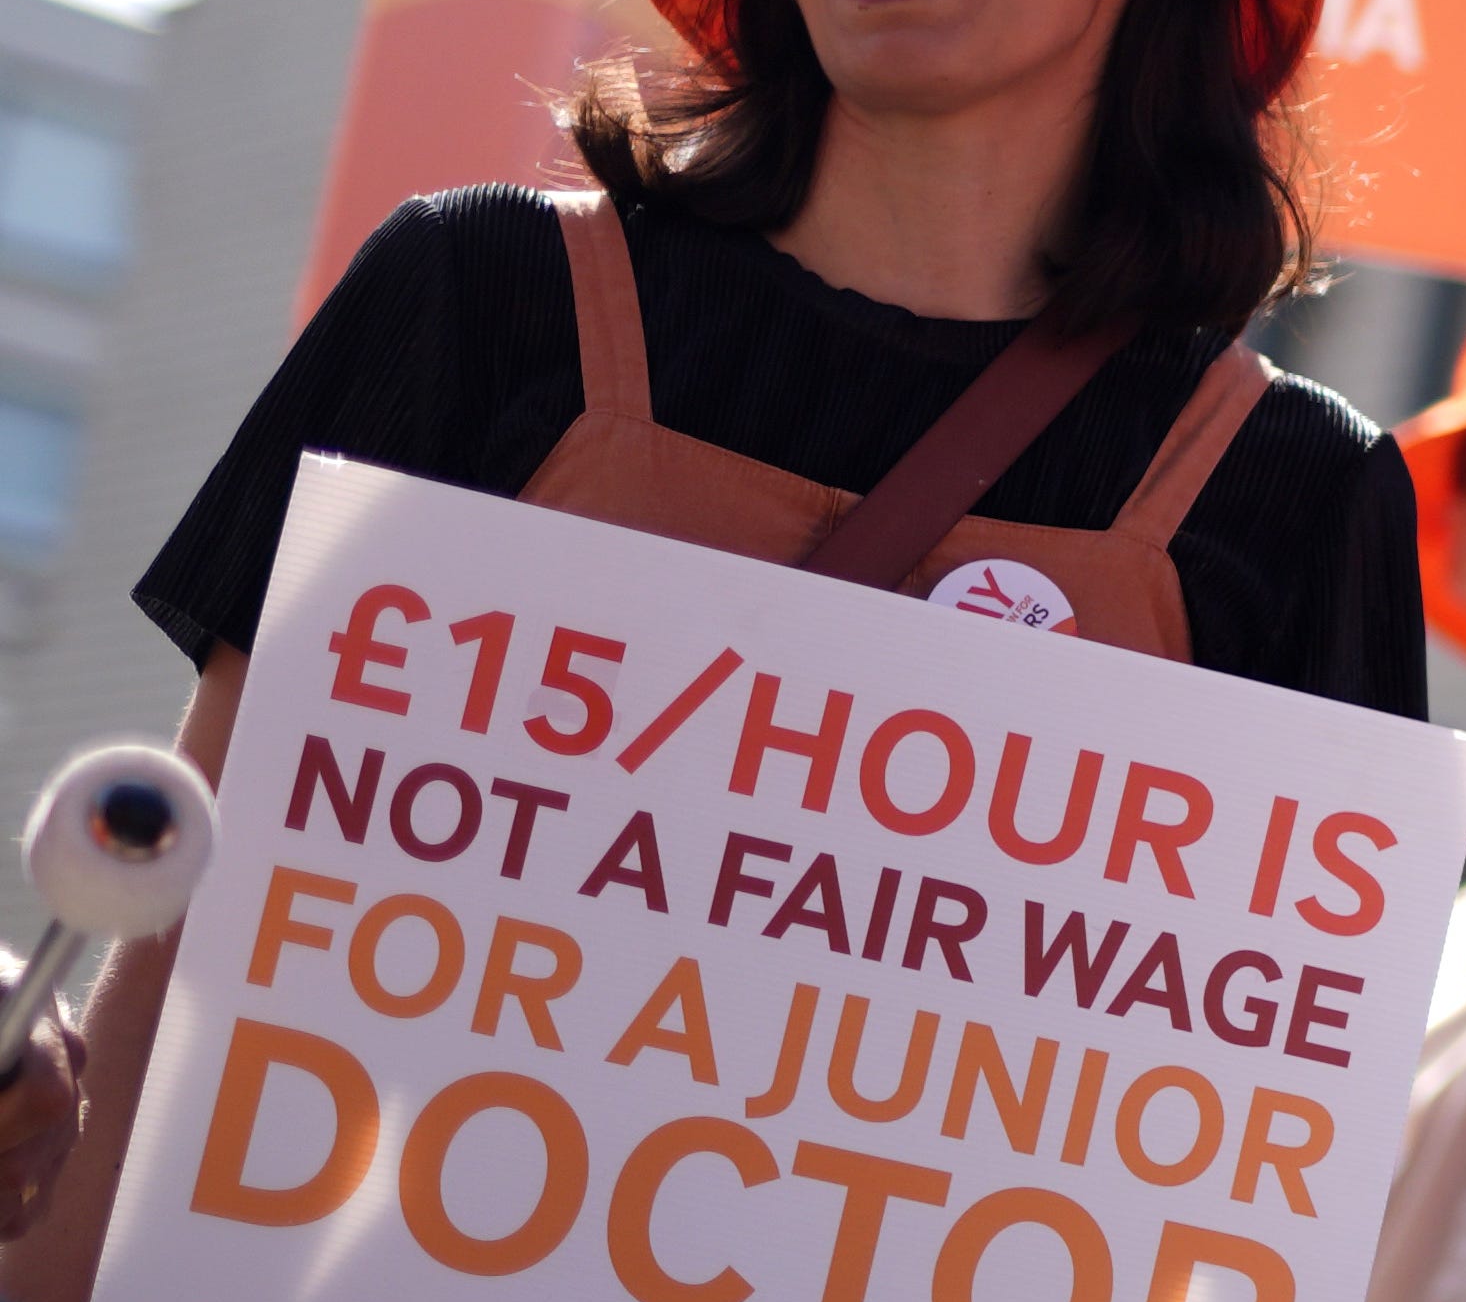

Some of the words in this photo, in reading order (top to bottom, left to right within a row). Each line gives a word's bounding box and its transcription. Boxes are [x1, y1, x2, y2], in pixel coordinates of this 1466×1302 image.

[284, 734, 570, 880] NOT
[580, 809, 670, 913] A
[708, 832, 988, 983] FAIR
[1022, 903, 1367, 1069] WAGE
[328, 584, 1214, 902] £15/HOUR
[1248, 797, 1400, 936] IS
[245, 864, 583, 1051] FOR
[603, 956, 721, 1086] A
[745, 980, 1336, 1219] JUNIOR
